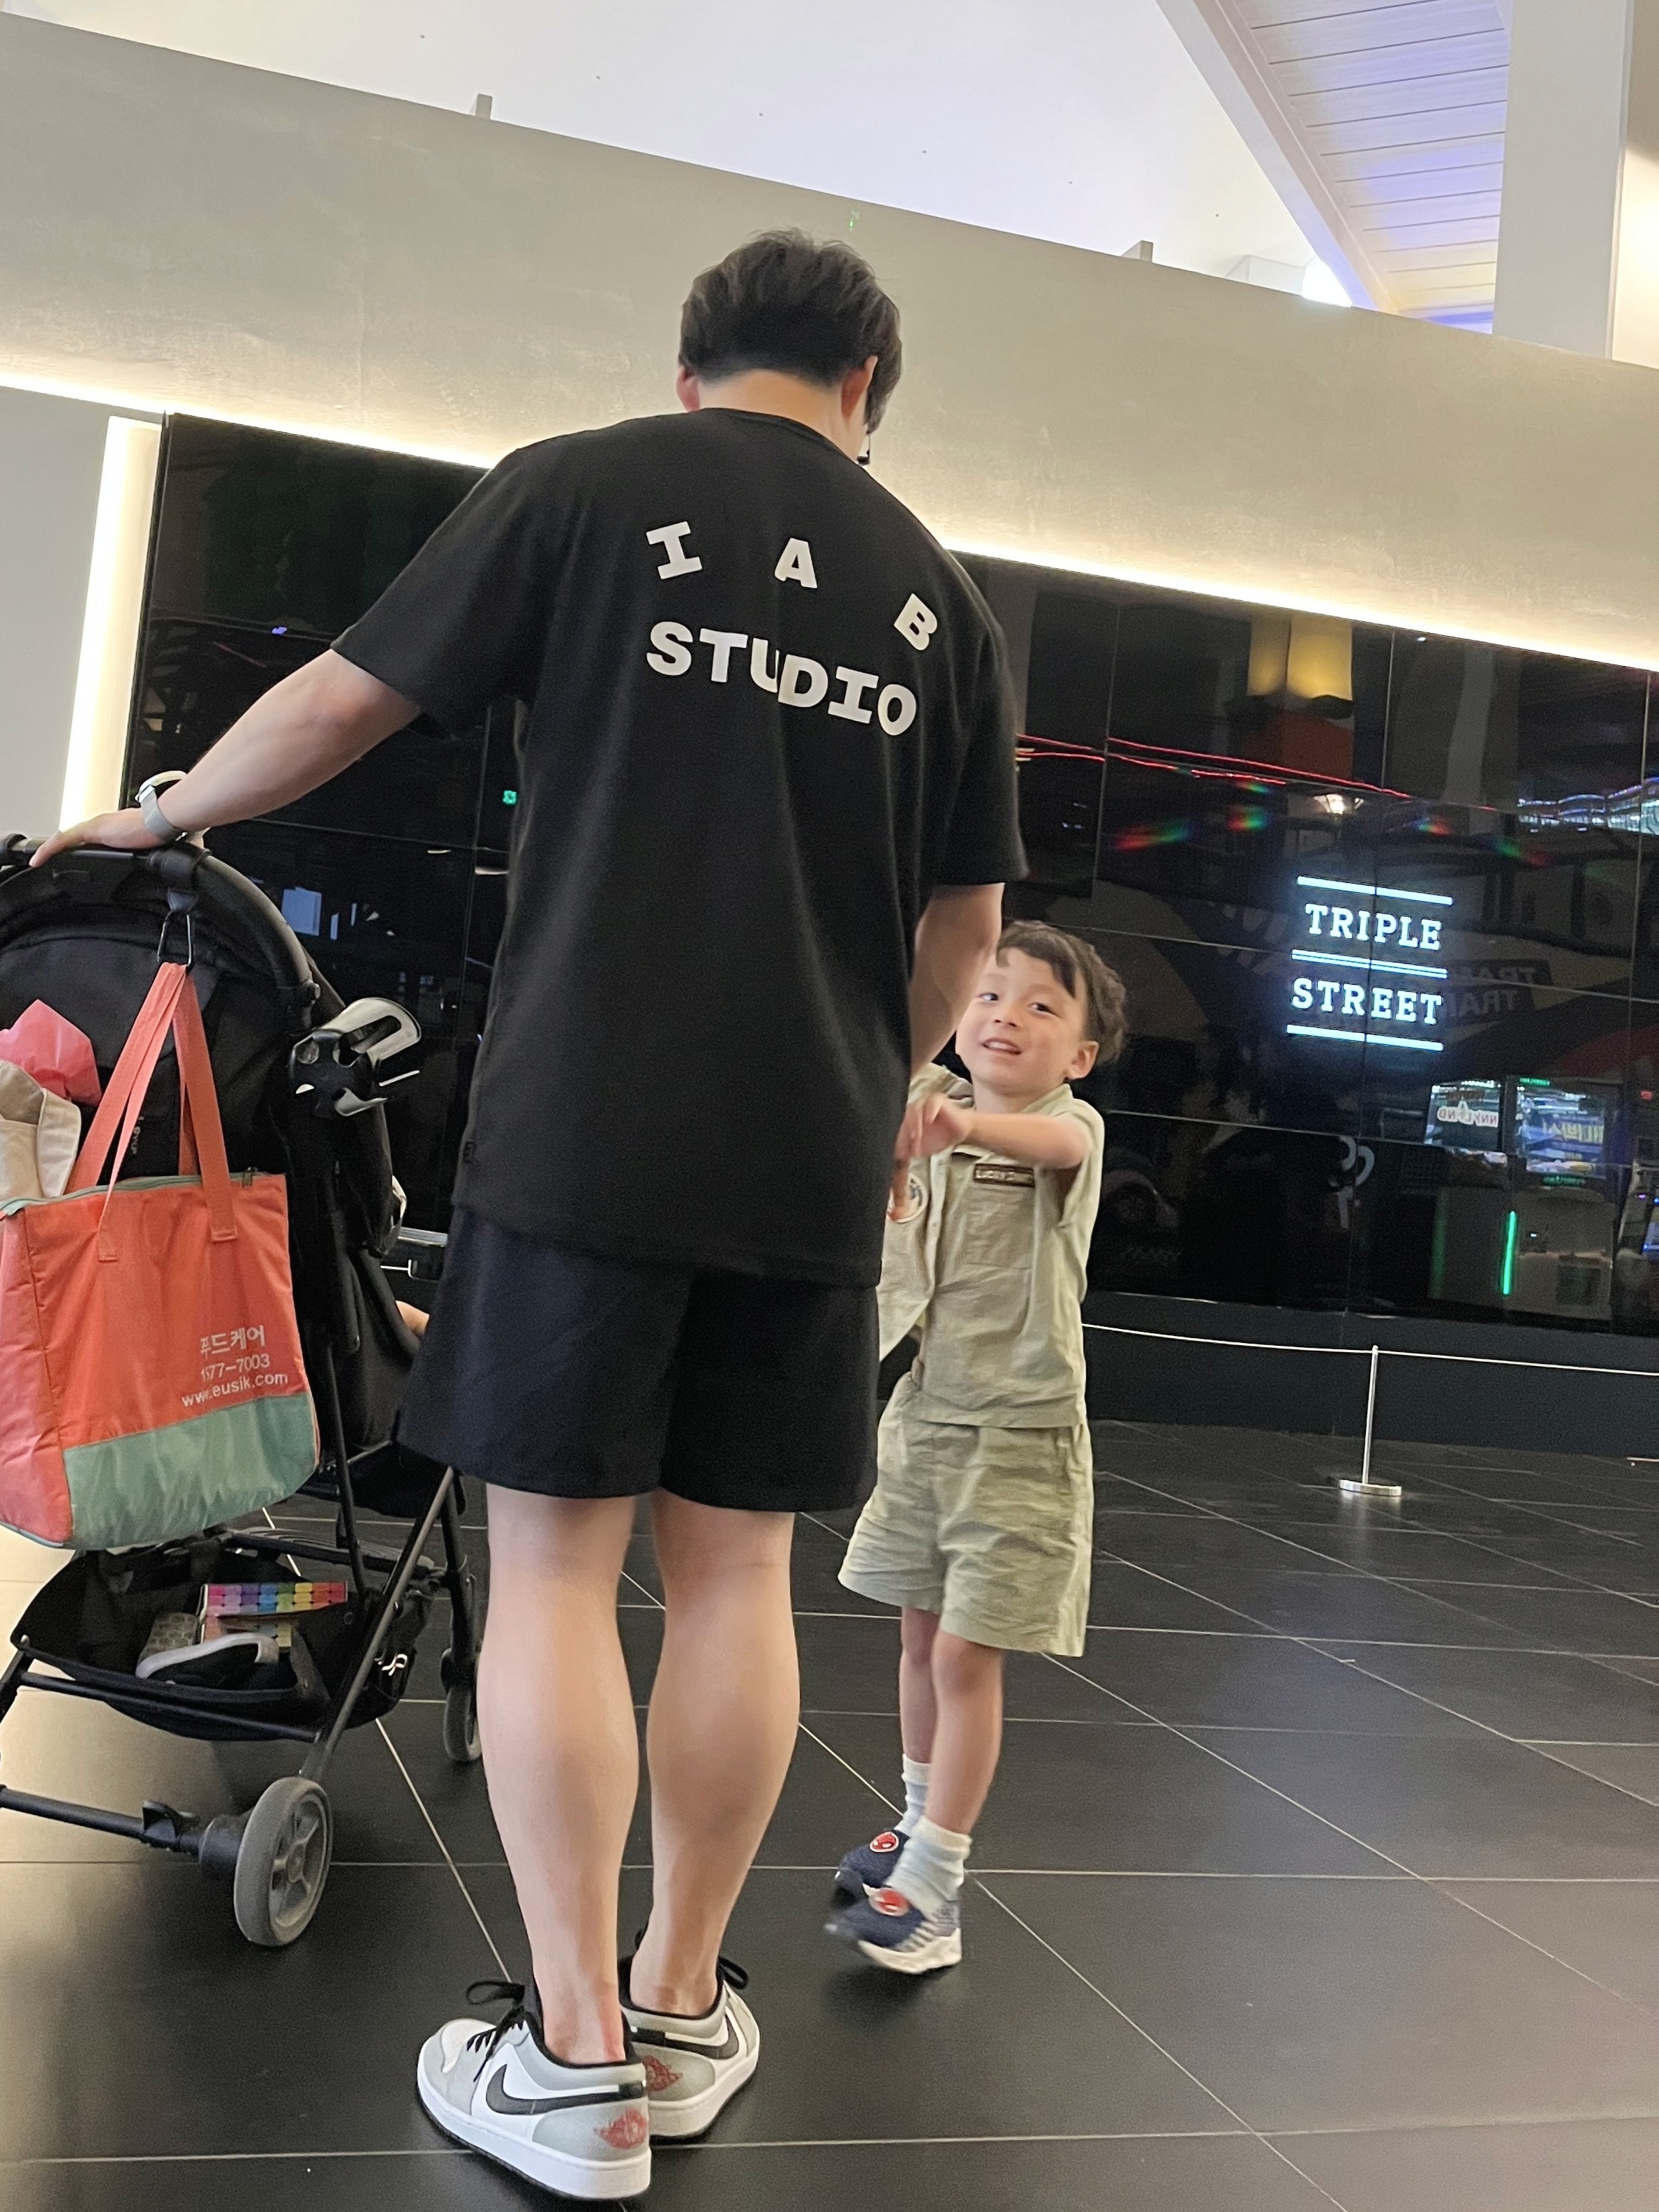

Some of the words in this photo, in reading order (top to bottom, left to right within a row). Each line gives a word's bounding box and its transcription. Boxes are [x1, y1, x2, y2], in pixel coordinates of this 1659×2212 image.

[646, 621, 916, 736] STUDIO
[1304, 903, 1442, 951] TRIPLE
[1292, 977, 1443, 1025] STREET
[200, 1325, 265, 1360] 푸드케어
